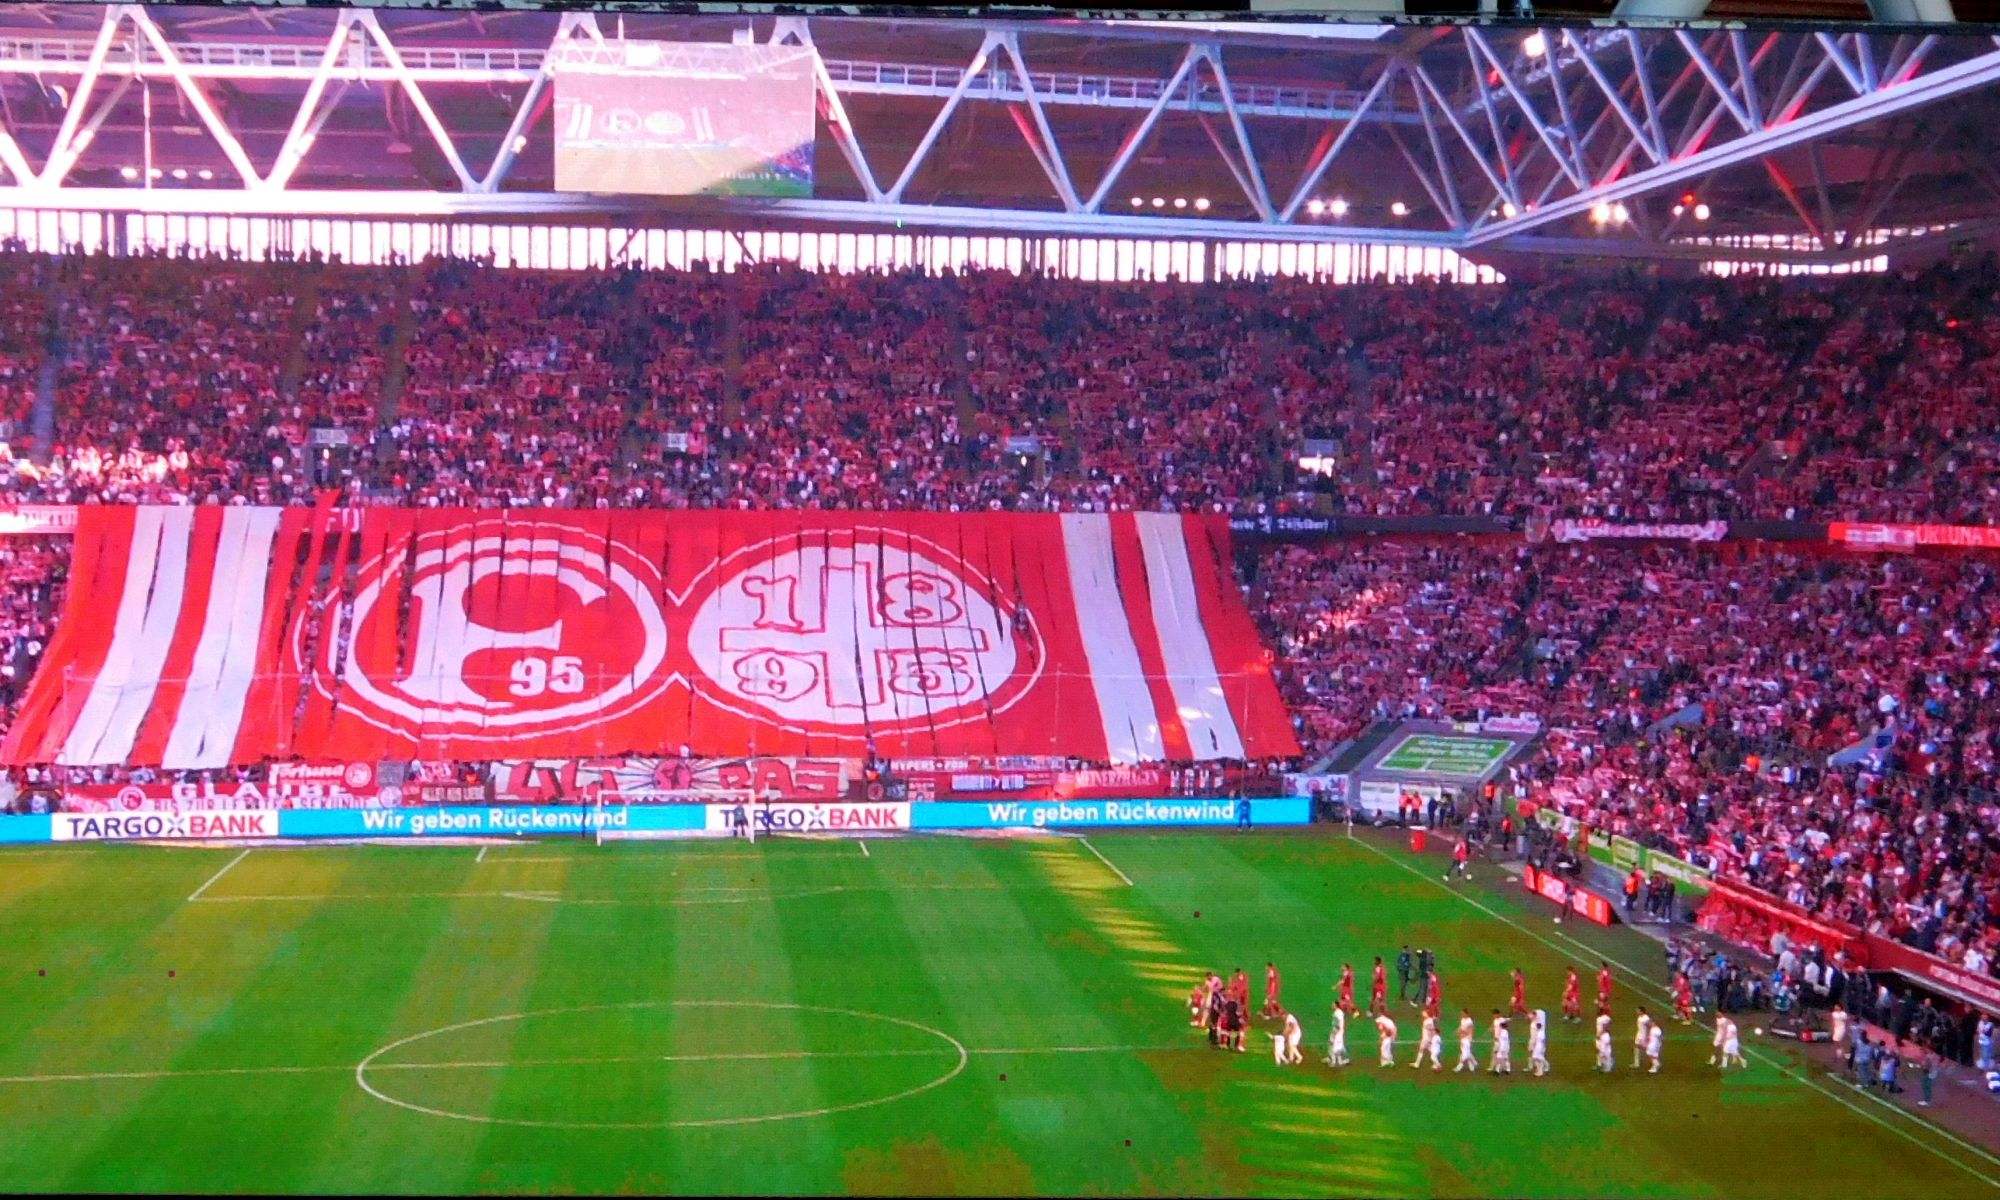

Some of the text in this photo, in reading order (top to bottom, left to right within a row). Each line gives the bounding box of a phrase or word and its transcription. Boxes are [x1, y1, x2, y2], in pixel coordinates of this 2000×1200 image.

[508, 656, 586, 697] 95
[361, 806, 628, 835] Wir geben Rückenwind
[987, 800, 1235, 827] Wir geben Rückenwind
